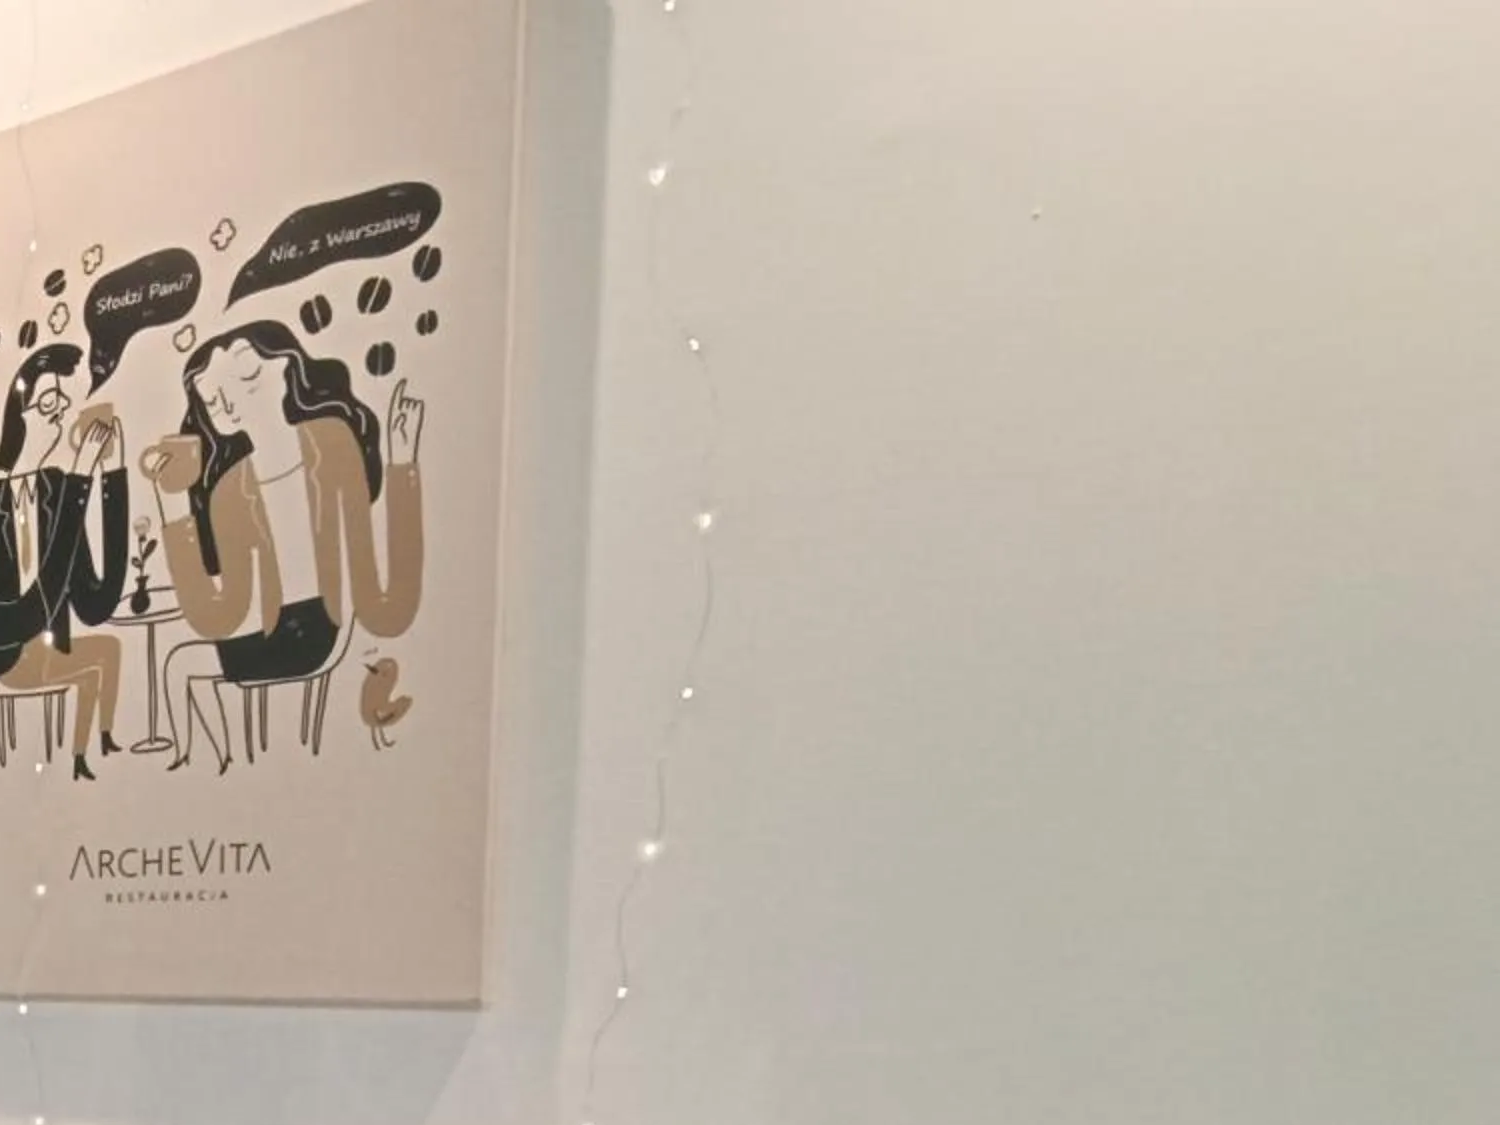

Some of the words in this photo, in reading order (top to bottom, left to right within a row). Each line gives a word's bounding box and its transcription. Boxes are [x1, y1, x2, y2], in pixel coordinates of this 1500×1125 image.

[308, 239, 320, 253] z
[325, 211, 422, 248] Warszawy
[148, 272, 193, 301] Pani?
[105, 889, 229, 904] RESTAURACJA
